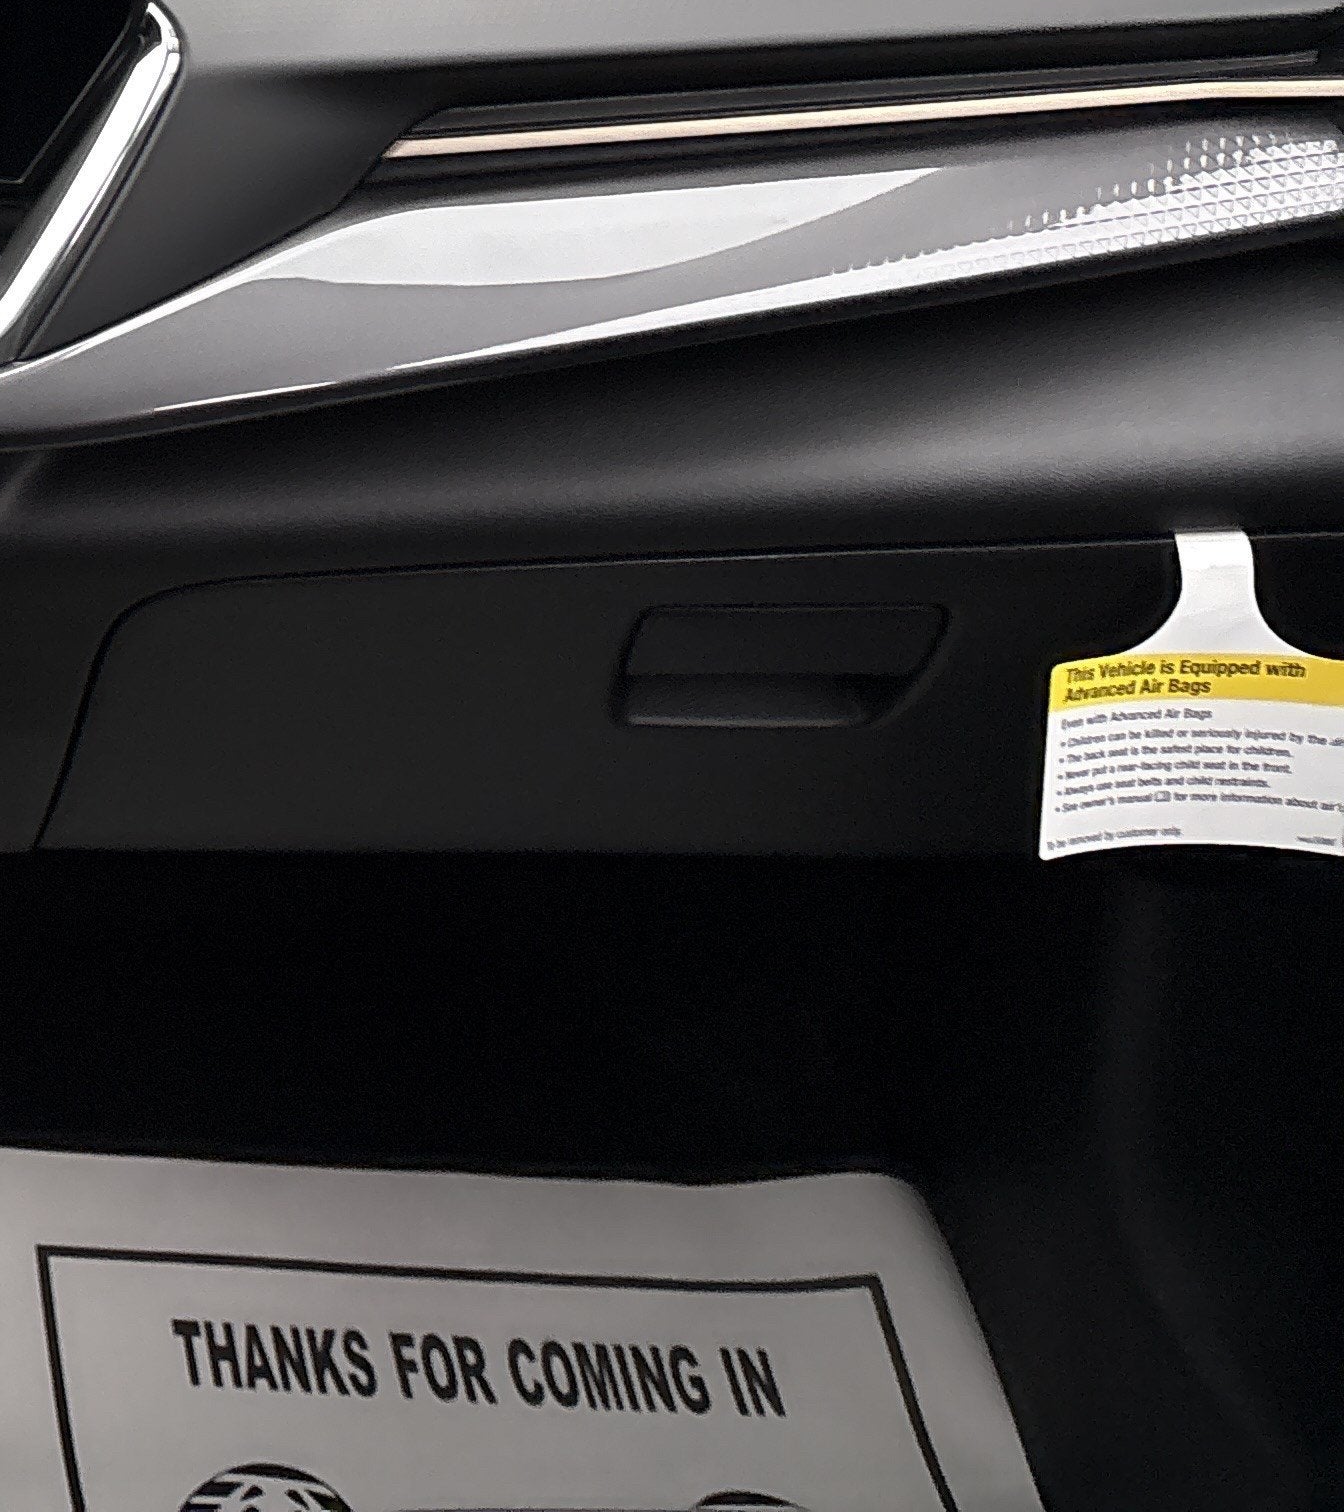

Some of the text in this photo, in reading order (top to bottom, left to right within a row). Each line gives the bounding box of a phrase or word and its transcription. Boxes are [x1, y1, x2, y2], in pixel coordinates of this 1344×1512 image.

[1066, 659, 1306, 684] This Vehicle is Equipped with
[1064, 679, 1212, 702] Advanced Air Bags
[1111, 709, 1162, 721] Advanced
[1164, 708, 1180, 719] Air
[1183, 707, 1212, 720] Bags
[171, 1318, 786, 1418] THANKS FOR COMING IN
